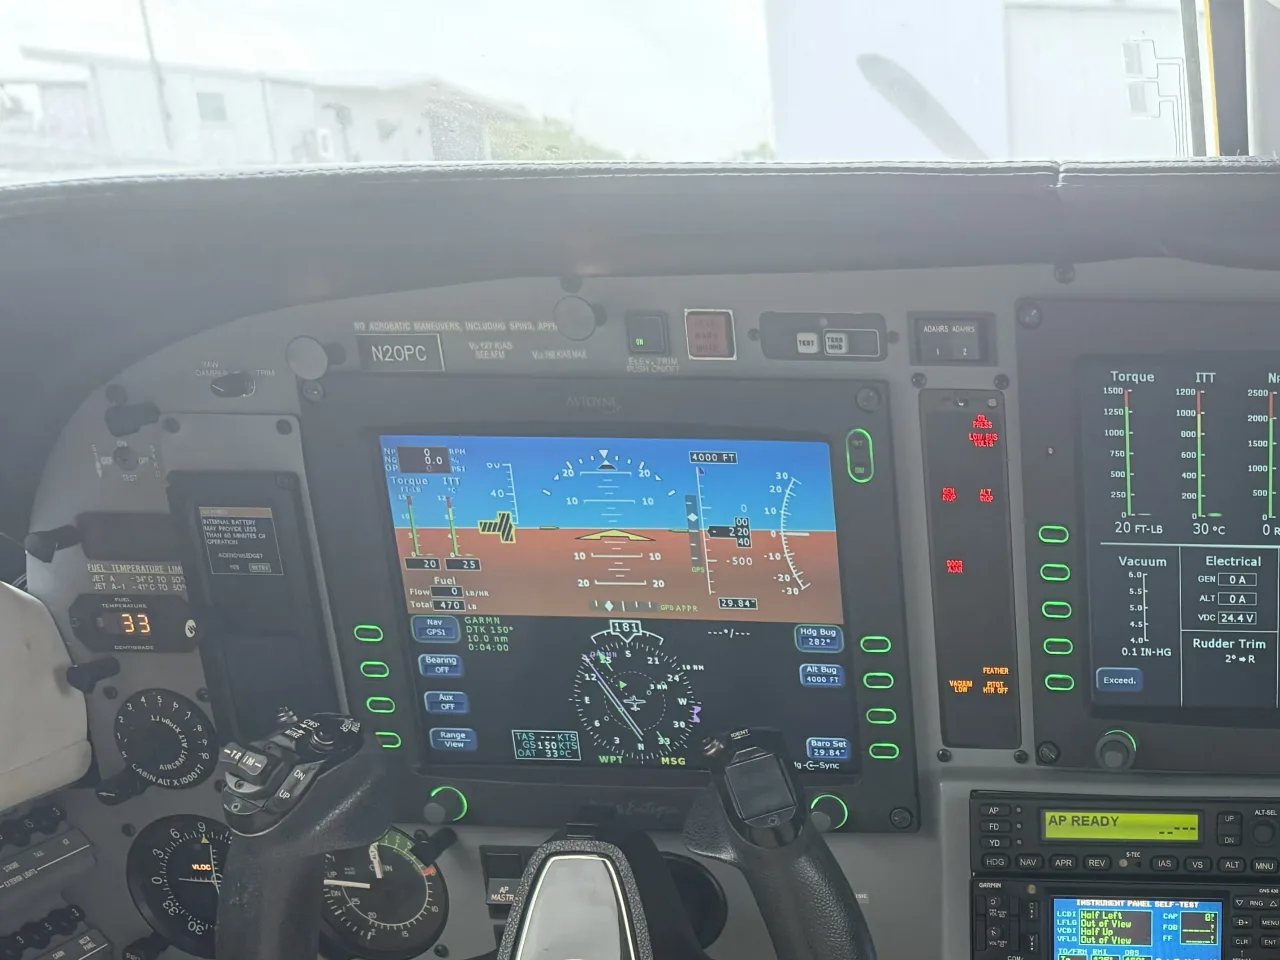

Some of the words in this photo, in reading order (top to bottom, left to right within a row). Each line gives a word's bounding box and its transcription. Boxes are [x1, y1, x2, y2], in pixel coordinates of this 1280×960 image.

[1110, 371, 1155, 384] Torque
[1195, 372, 1216, 383] ITT
[692, 453, 719, 462] 4000
[722, 453, 735, 463] FT
[1114, 522, 1130, 533] 20
[1135, 525, 1162, 533] FT-LB
[1193, 524, 1208, 534] 30
[1119, 557, 1167, 566] Vacuum
[1206, 557, 1261, 566] Electrical
[439, 601, 460, 610] 470
[122, 614, 150, 632] 33
[1221, 614, 1243, 623] 24.4
[1246, 614, 1253, 623] V
[615, 622, 639, 633] 181
[467, 634, 487, 642] 10.0
[800, 628, 816, 637] Hdg
[819, 629, 836, 638] Bug
[1193, 639, 1234, 649] Rudder
[1238, 639, 1266, 649] Trim
[425, 656, 456, 666] Bearing
[435, 666, 449, 674] OFF
[1104, 676, 1136, 684] Exceed.
[440, 732, 466, 741] Range
[599, 756, 623, 764] WPT
[661, 757, 685, 765] MSG
[1049, 816, 1067, 825] AP
[1072, 816, 1119, 826] READY
